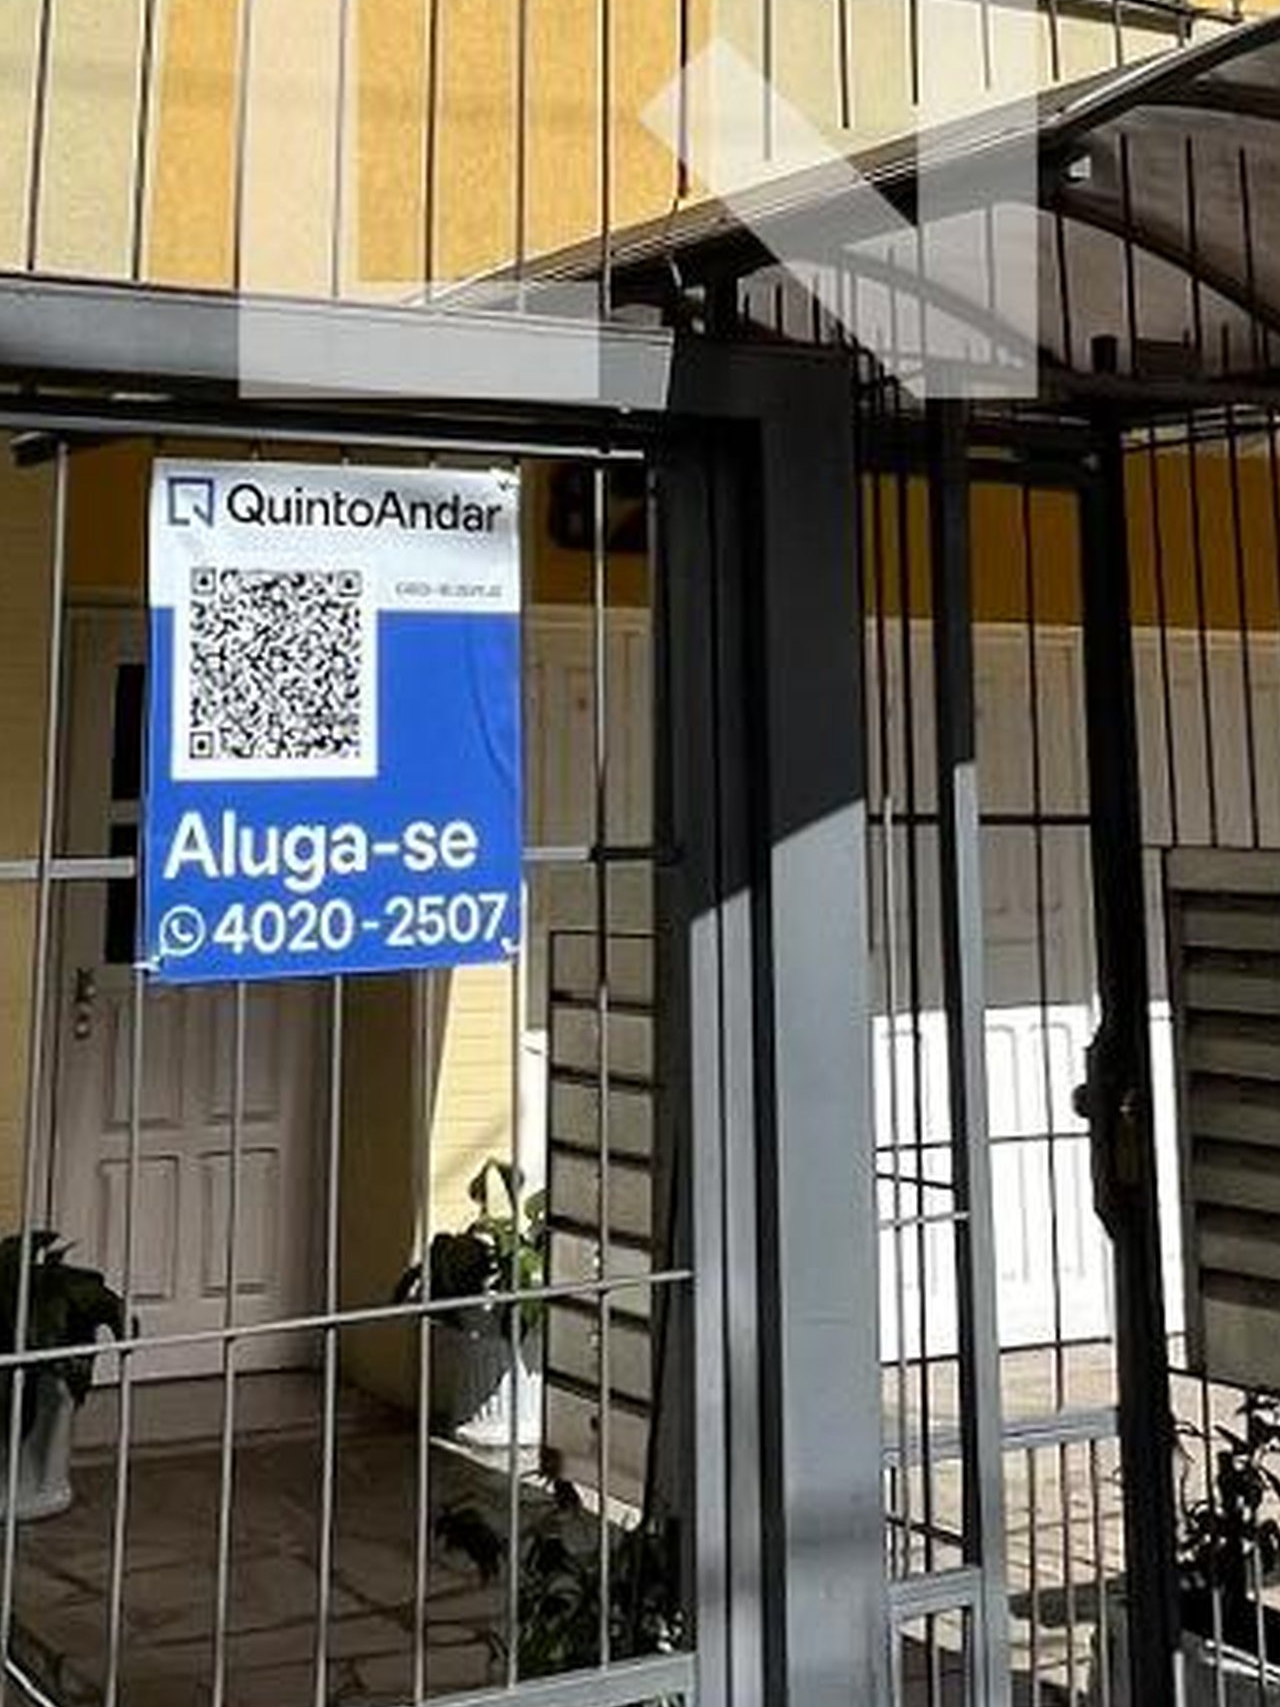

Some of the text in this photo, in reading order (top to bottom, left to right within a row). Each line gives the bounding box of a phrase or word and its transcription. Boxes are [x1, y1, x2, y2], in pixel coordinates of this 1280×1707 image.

[226, 482, 503, 534] QuintoAndar
[164, 810, 477, 890] Aluga-se
[212, 892, 508, 955] 4020-2507
